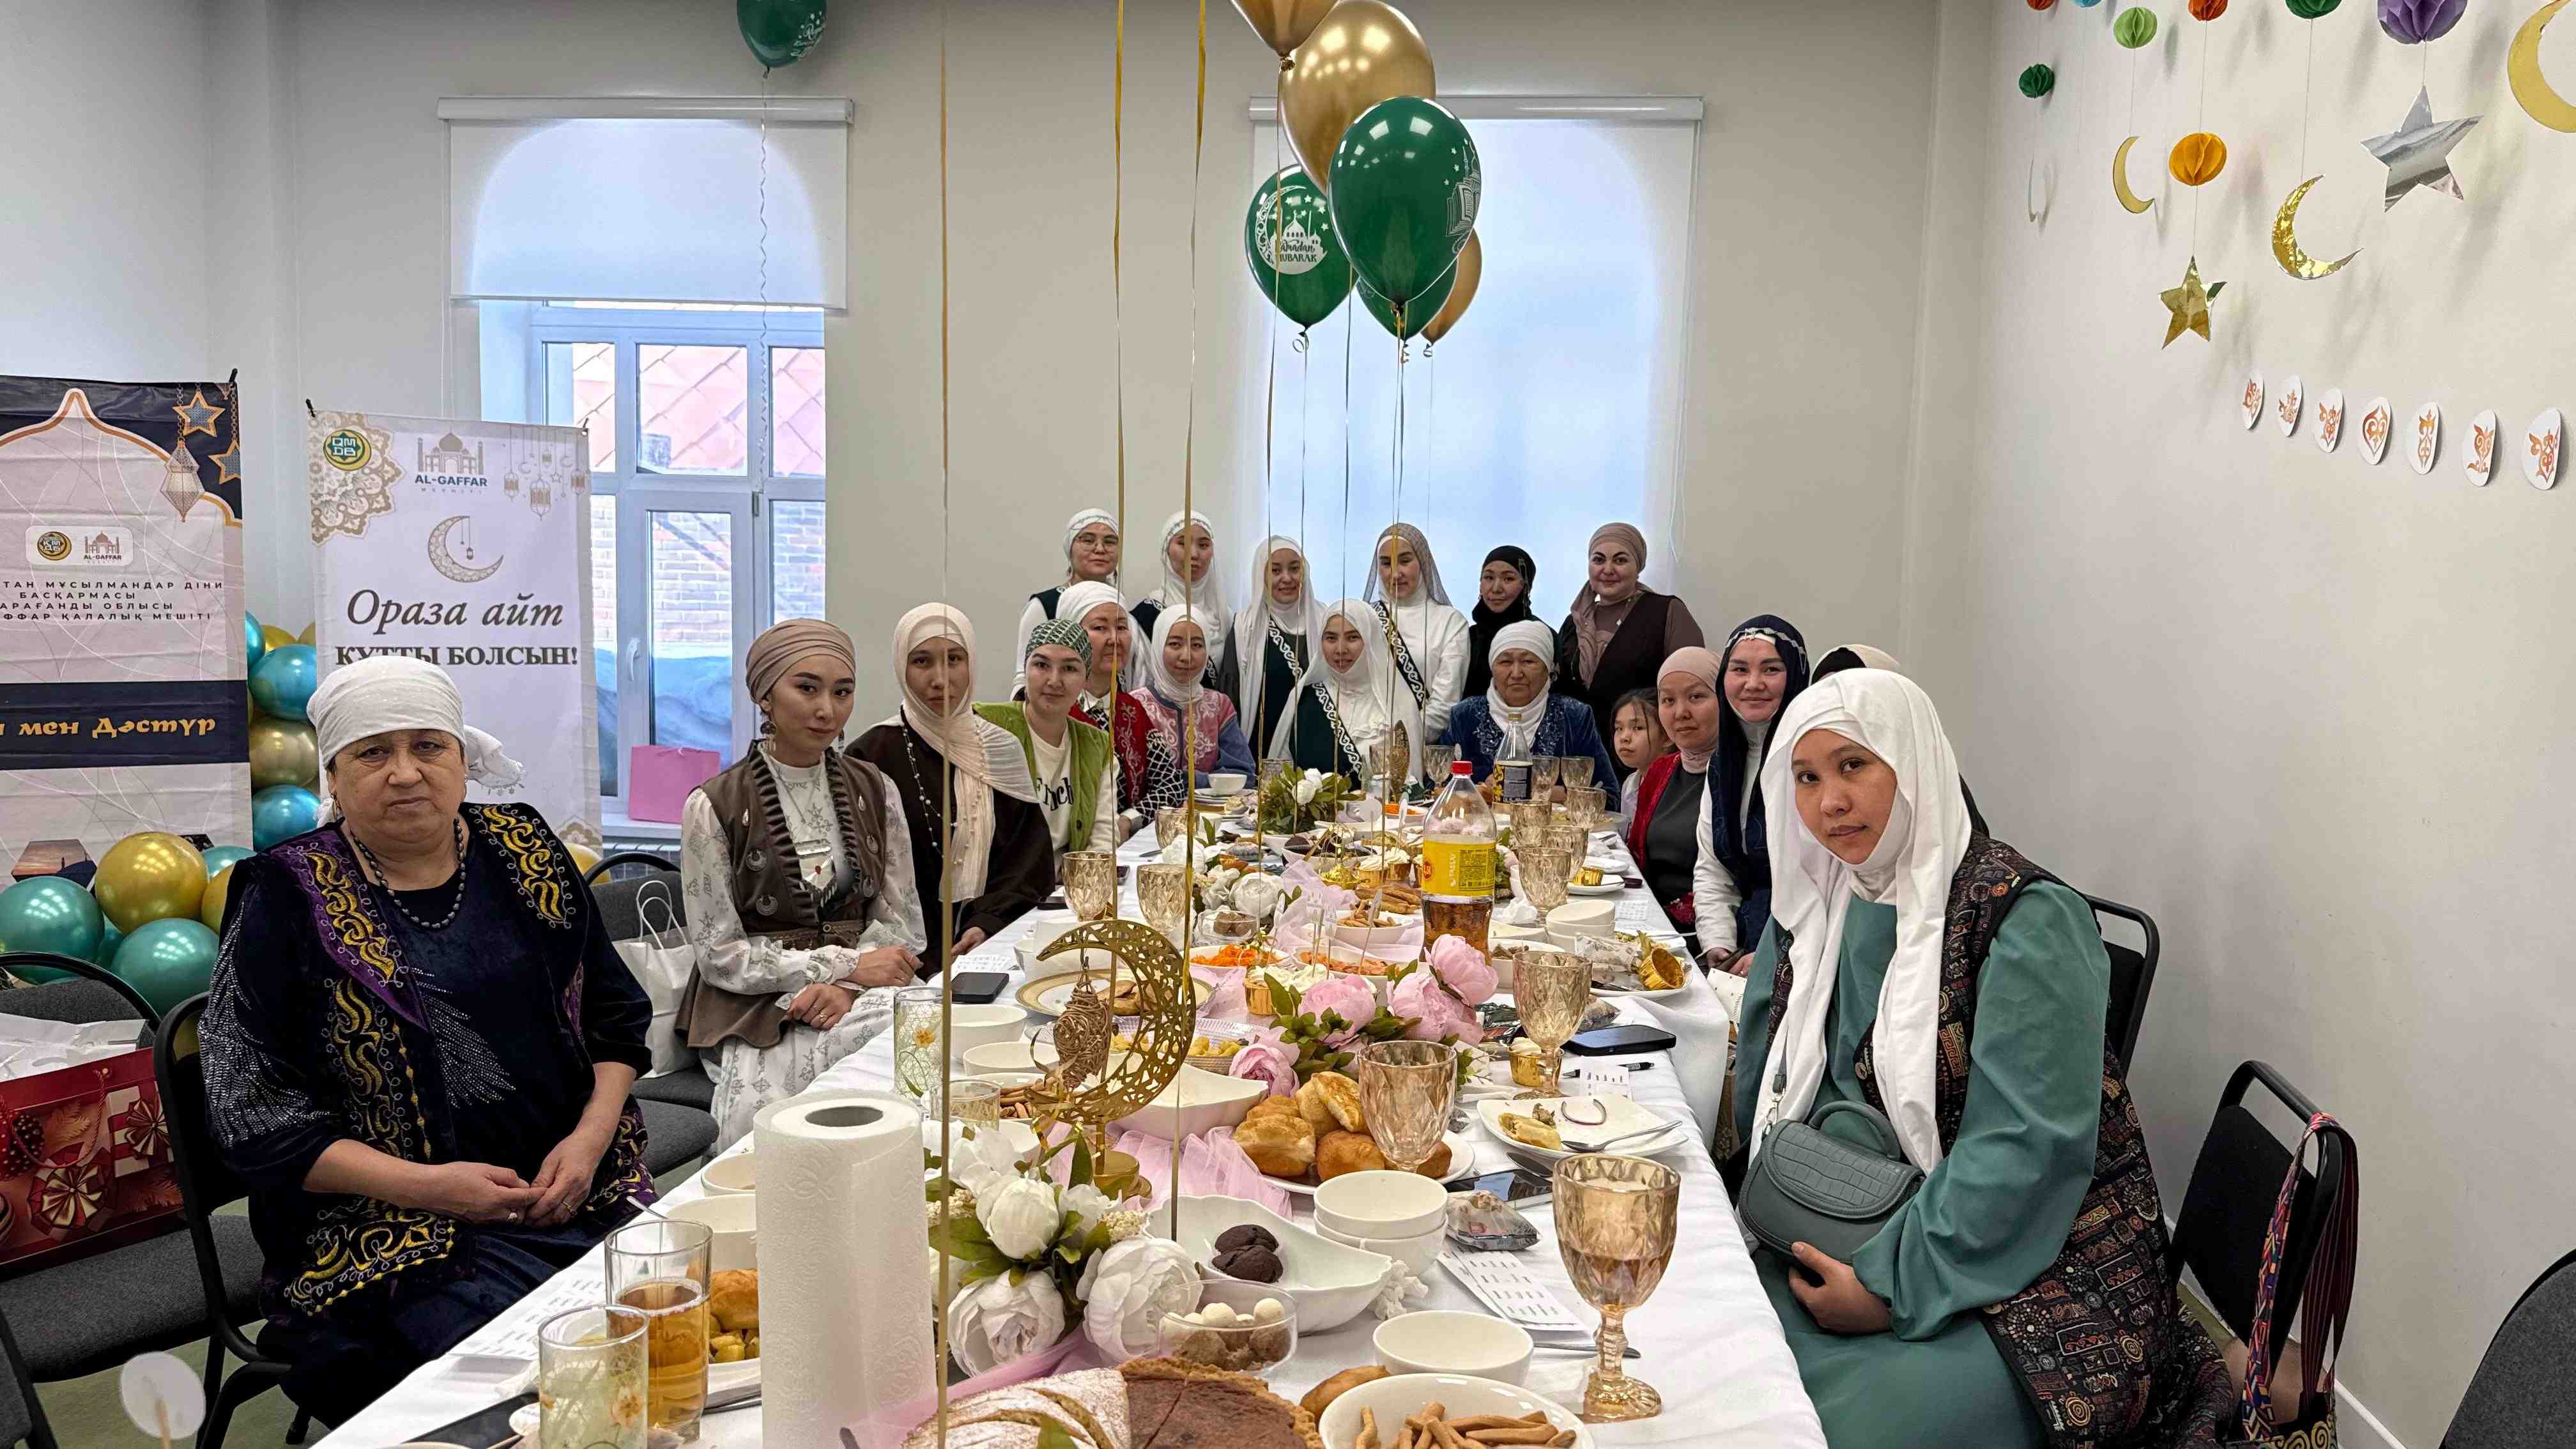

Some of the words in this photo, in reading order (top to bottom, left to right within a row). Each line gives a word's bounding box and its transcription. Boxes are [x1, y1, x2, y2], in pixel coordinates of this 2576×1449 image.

[414, 475, 488, 487] AL-GAFFAR
[184, 581, 222, 589] ДІНИ
[19, 592, 135, 600] БАСҚАРМАСЫ
[61, 613, 142, 622] ҚАЛАЛЫҚ
[152, 613, 211, 621] МЕШІТІ
[347, 589, 468, 636] Ораза
[481, 593, 564, 627] айт
[447, 646, 578, 666] БОЛСЫН!
[18, 721, 80, 735] мен
[91, 716, 216, 740] Дәстүр
